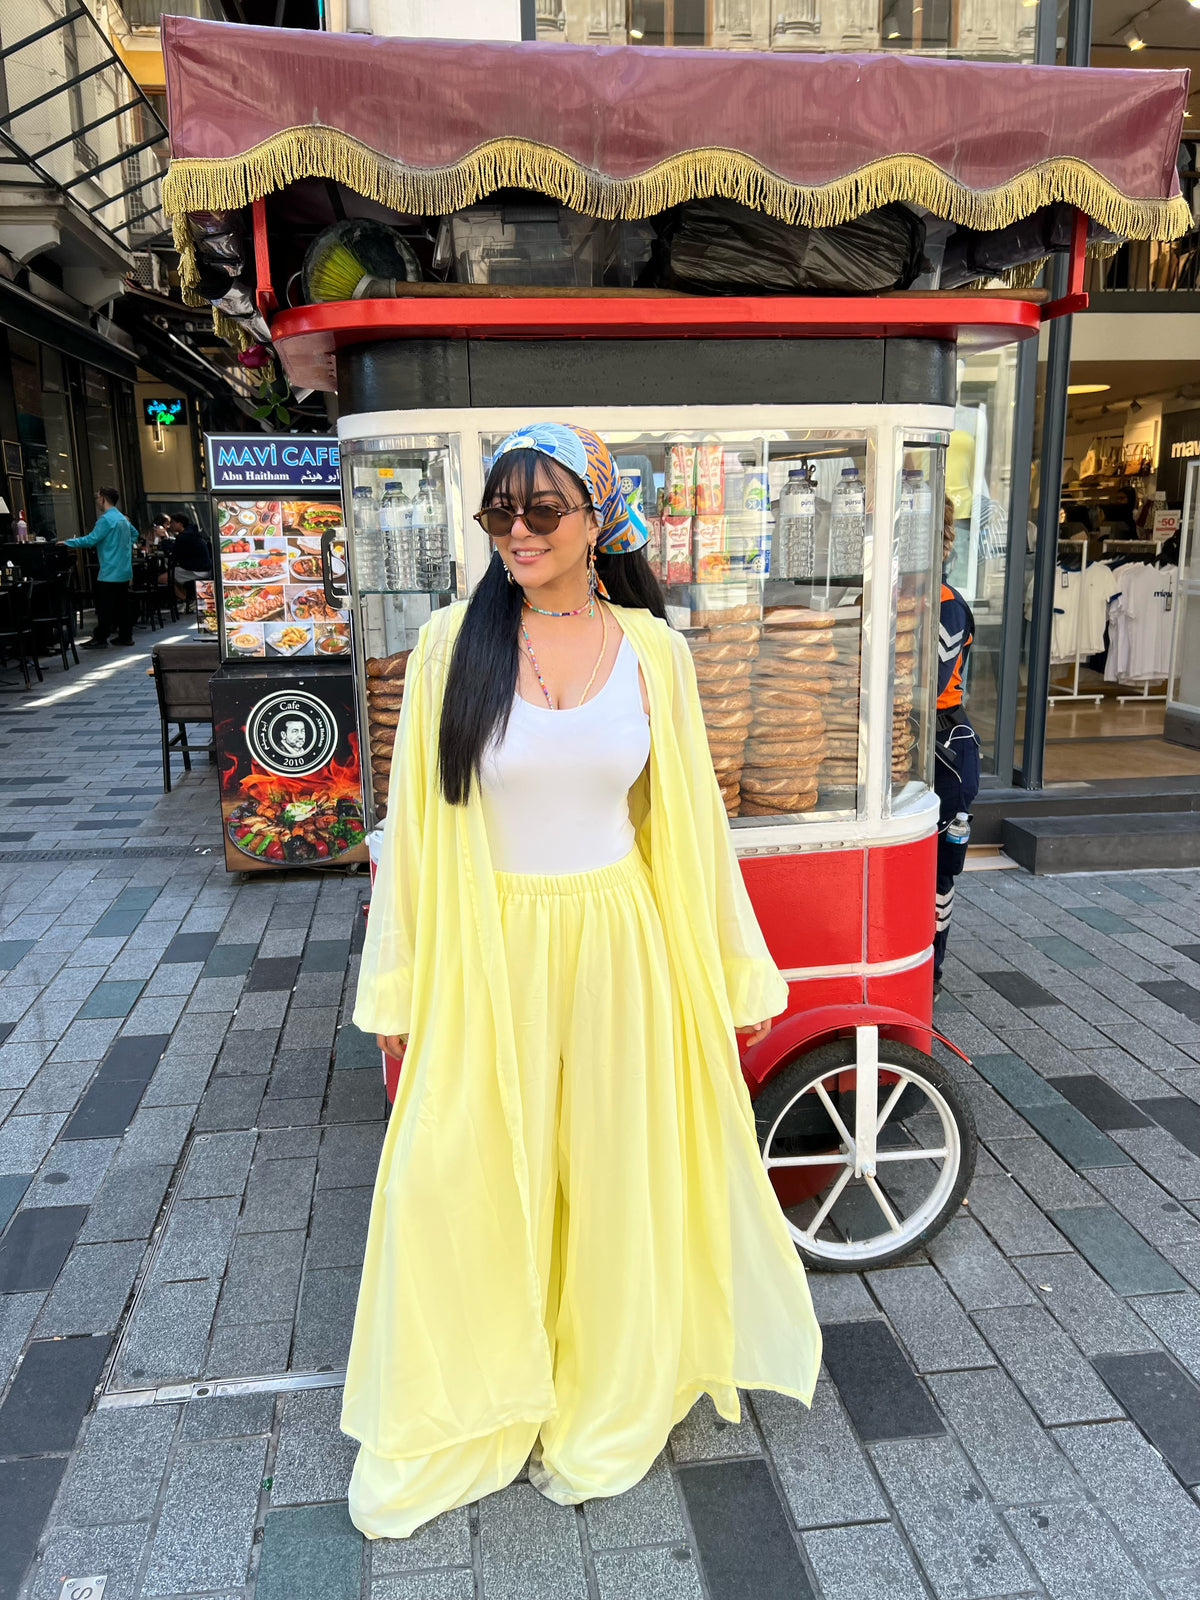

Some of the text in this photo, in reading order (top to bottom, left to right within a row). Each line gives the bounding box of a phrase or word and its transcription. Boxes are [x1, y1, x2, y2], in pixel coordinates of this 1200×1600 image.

[218, 443, 339, 466] MAVİ CAFE
[221, 471, 290, 481] Abu Haitham
[300, 470, 323, 484] هيثم
[280, 701, 300, 711] Cafe
[283, 758, 305, 767] 2010
